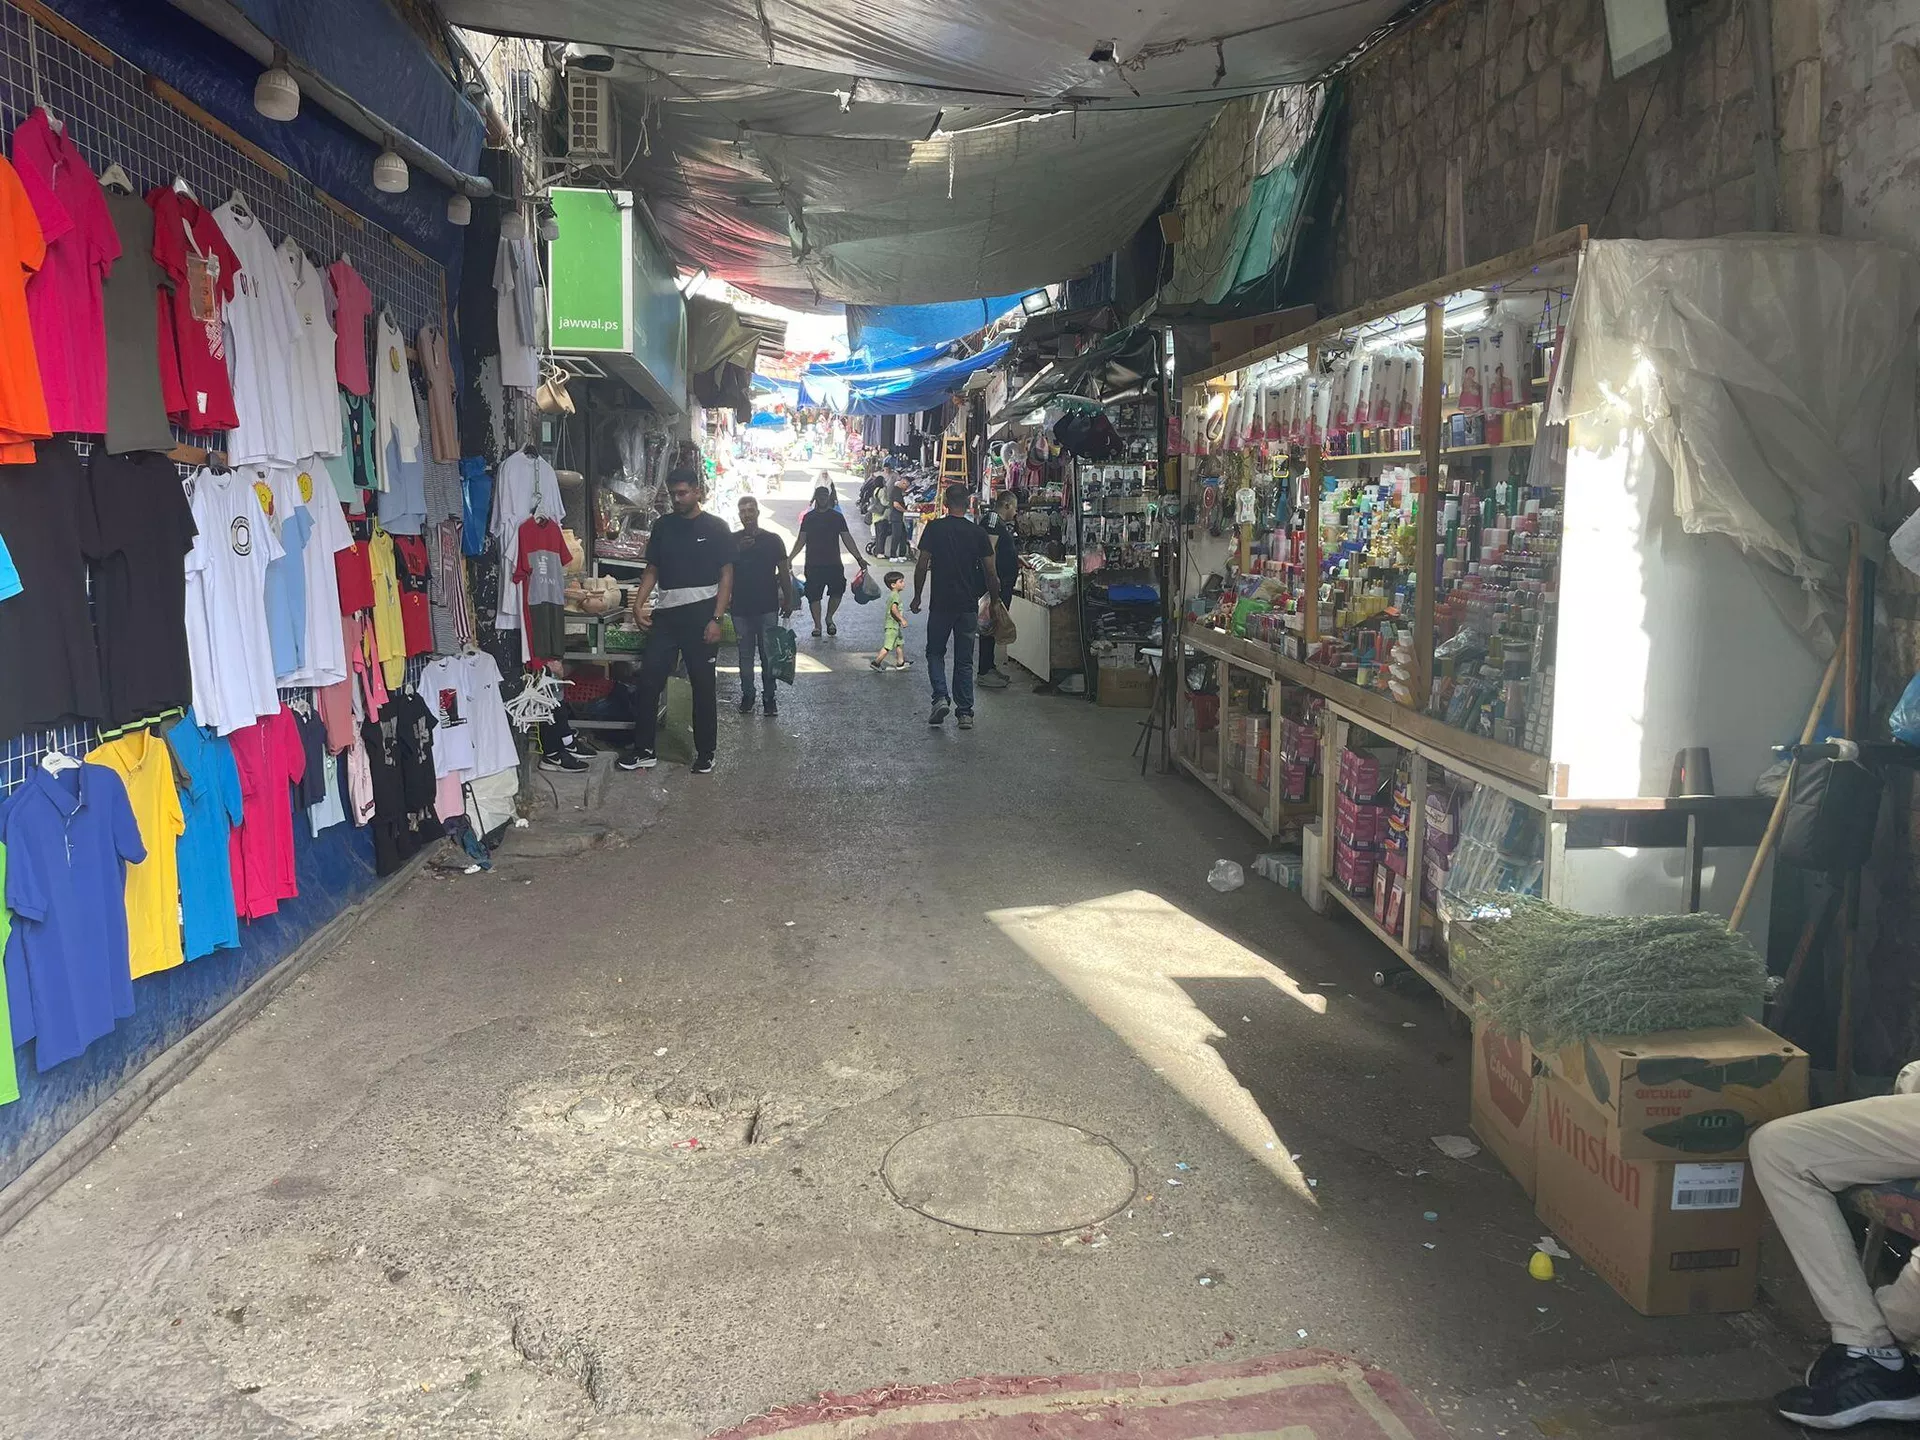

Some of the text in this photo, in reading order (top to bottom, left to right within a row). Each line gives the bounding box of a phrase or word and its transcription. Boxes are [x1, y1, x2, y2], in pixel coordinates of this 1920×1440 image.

[558, 316, 619, 331] jawwal.ps
[1489, 1056, 1525, 1105] CAPITAL
[1545, 1084, 1641, 1211] Winston
